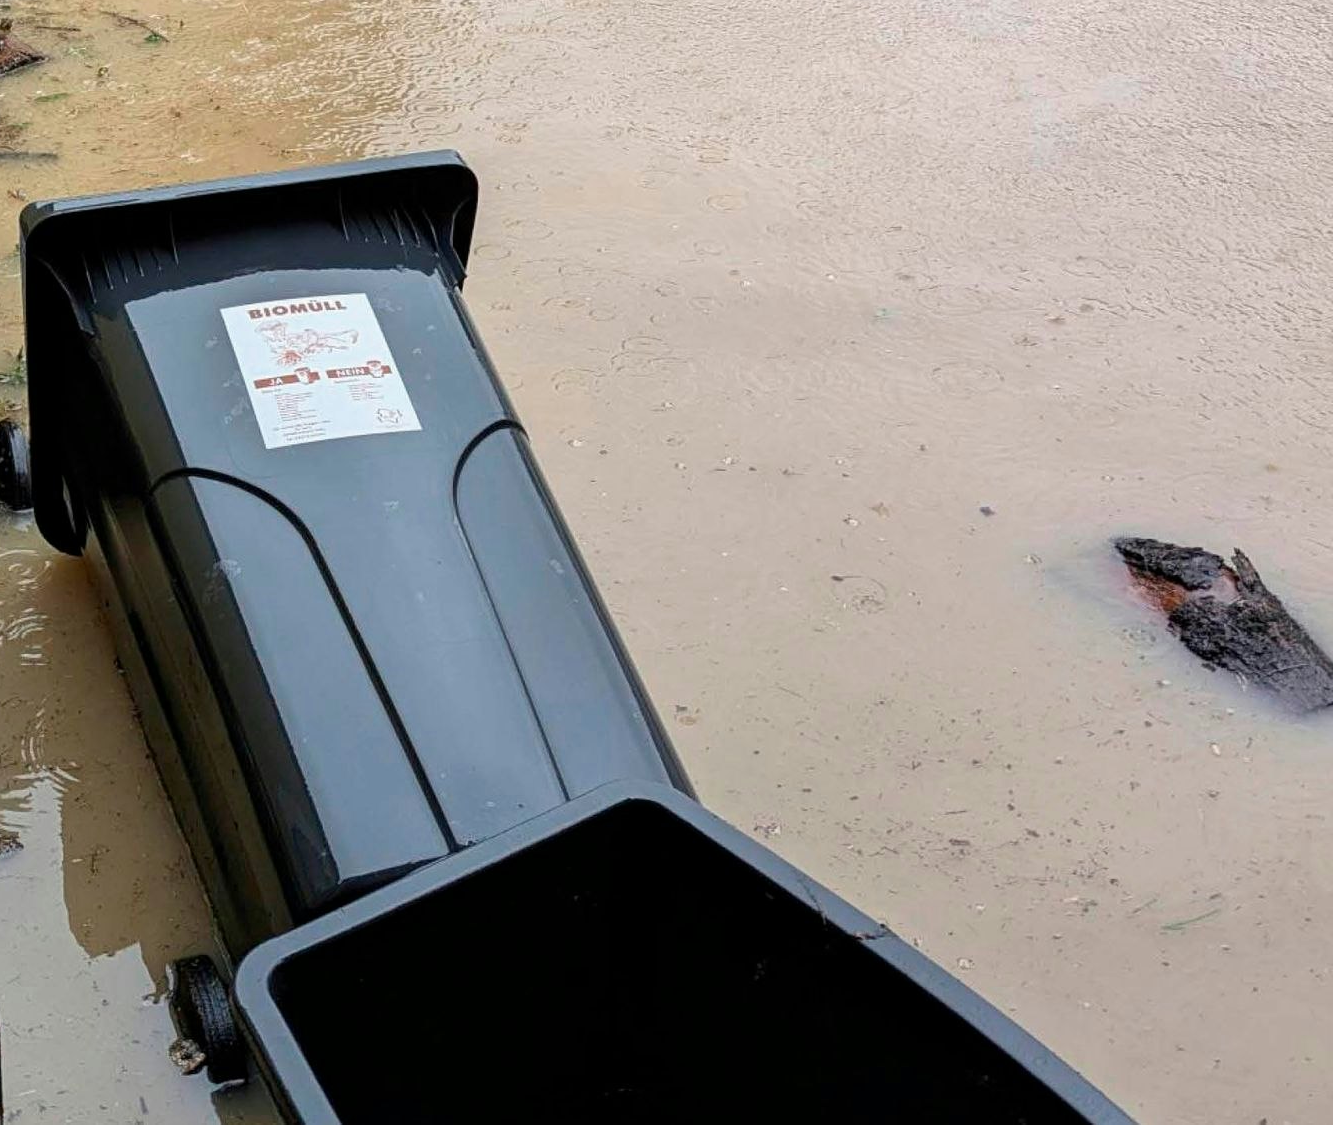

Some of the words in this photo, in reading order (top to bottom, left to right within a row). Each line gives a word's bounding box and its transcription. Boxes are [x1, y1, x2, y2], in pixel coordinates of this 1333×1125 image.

[247, 300, 347, 319] BIOMÜLL
[335, 366, 365, 378] NEIN
[268, 377, 283, 387] JA
